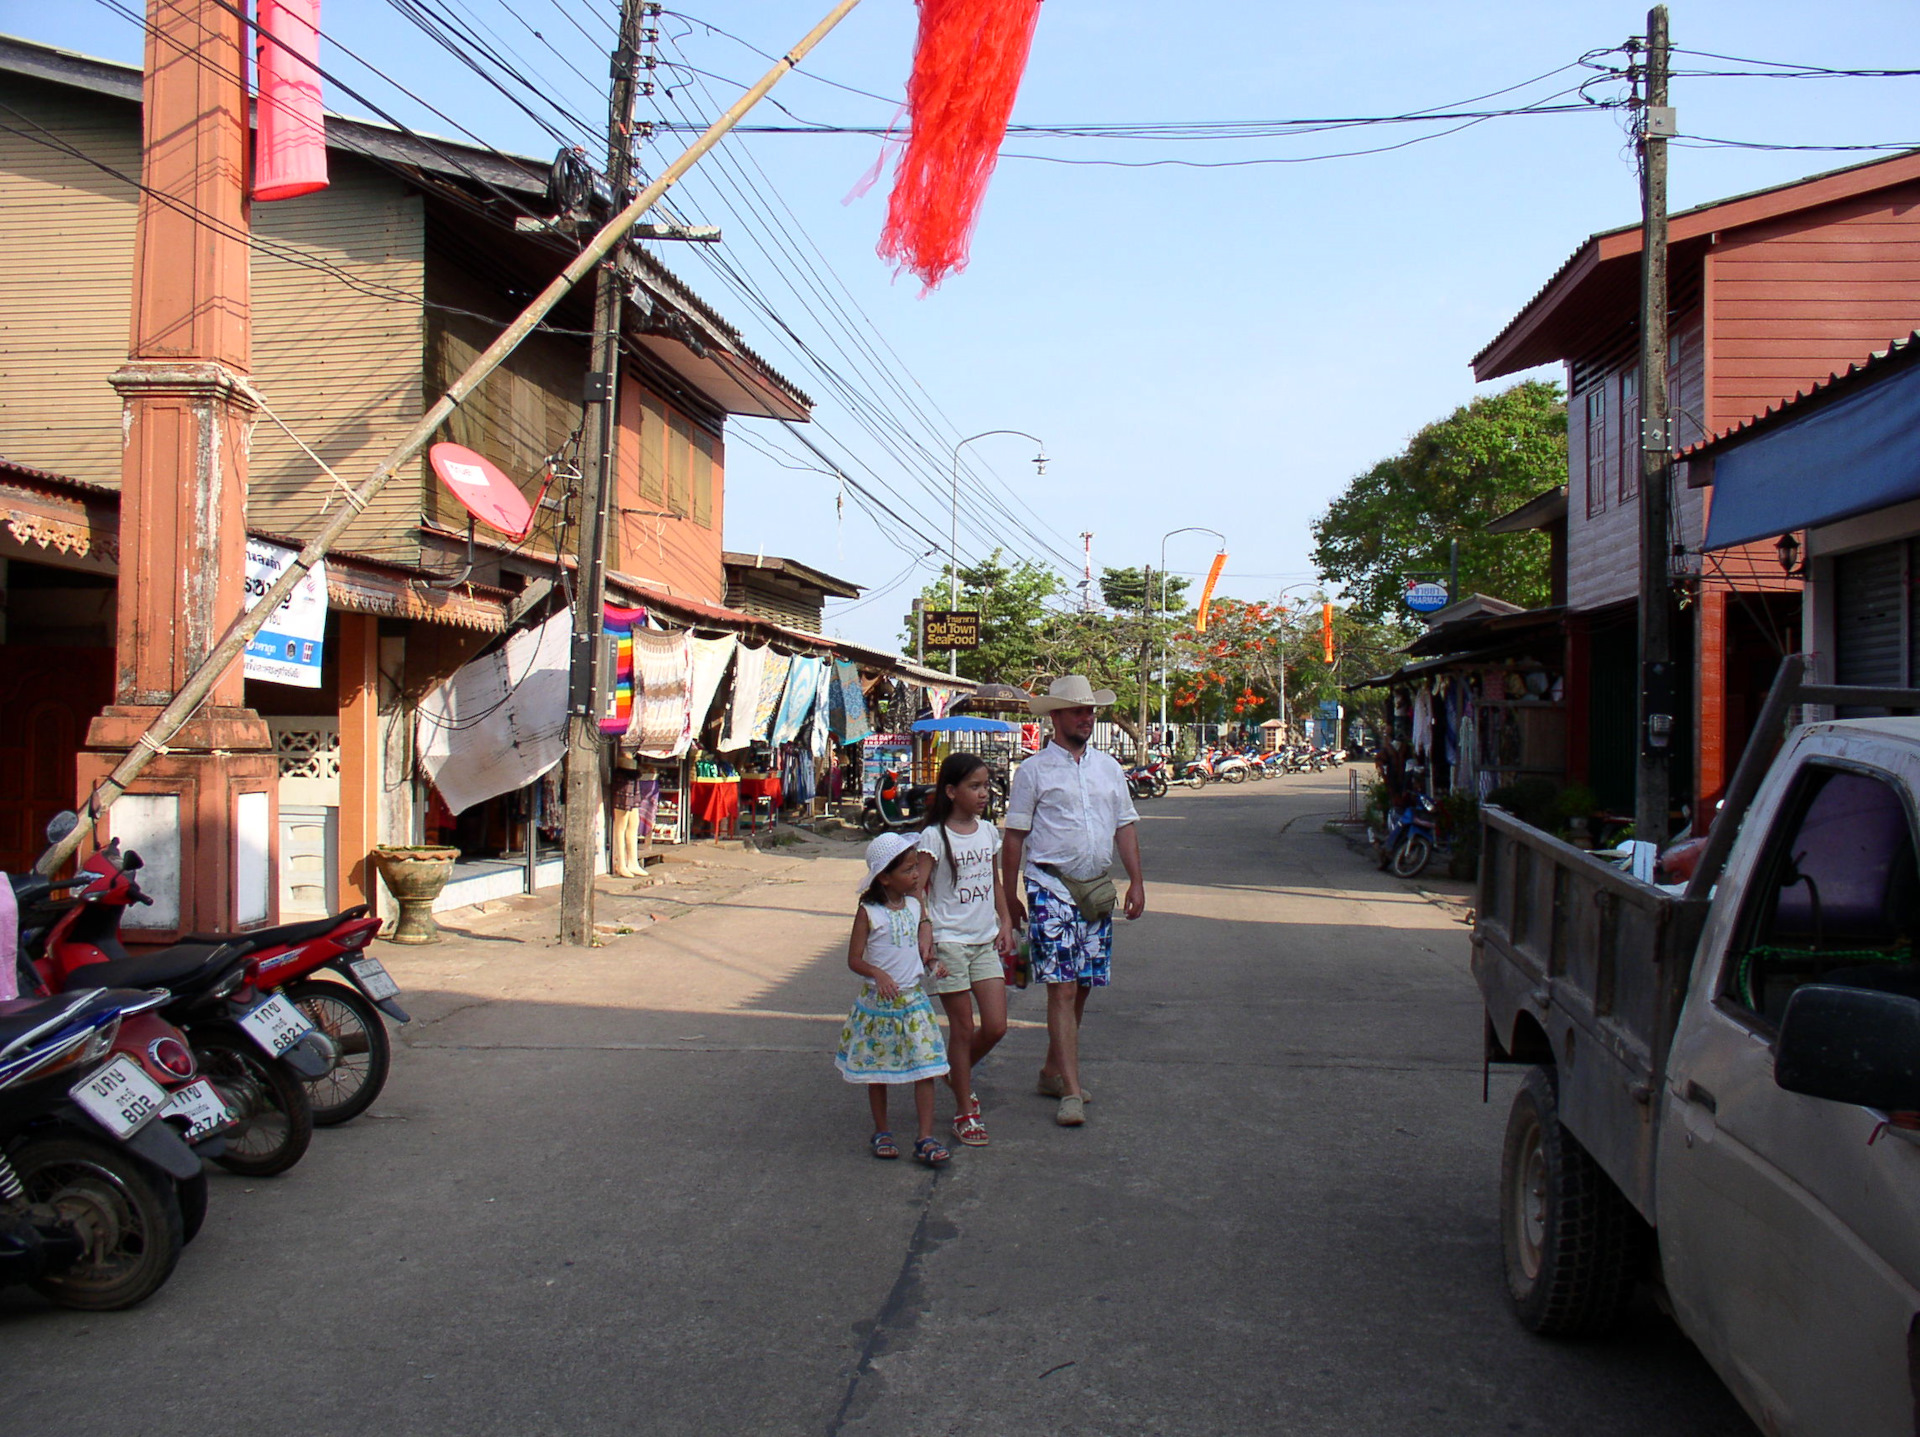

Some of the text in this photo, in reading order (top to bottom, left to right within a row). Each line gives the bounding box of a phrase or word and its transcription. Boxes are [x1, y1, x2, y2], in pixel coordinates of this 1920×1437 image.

[1407, 596, 1448, 605] PHARMACY
[927, 622, 977, 634] Old Town
[927, 633, 977, 645] SeaFood
[954, 847, 992, 866] HAVE
[958, 884, 992, 904] DAY
[273, 1022, 306, 1050] 6821
[121, 1095, 156, 1124] 802
